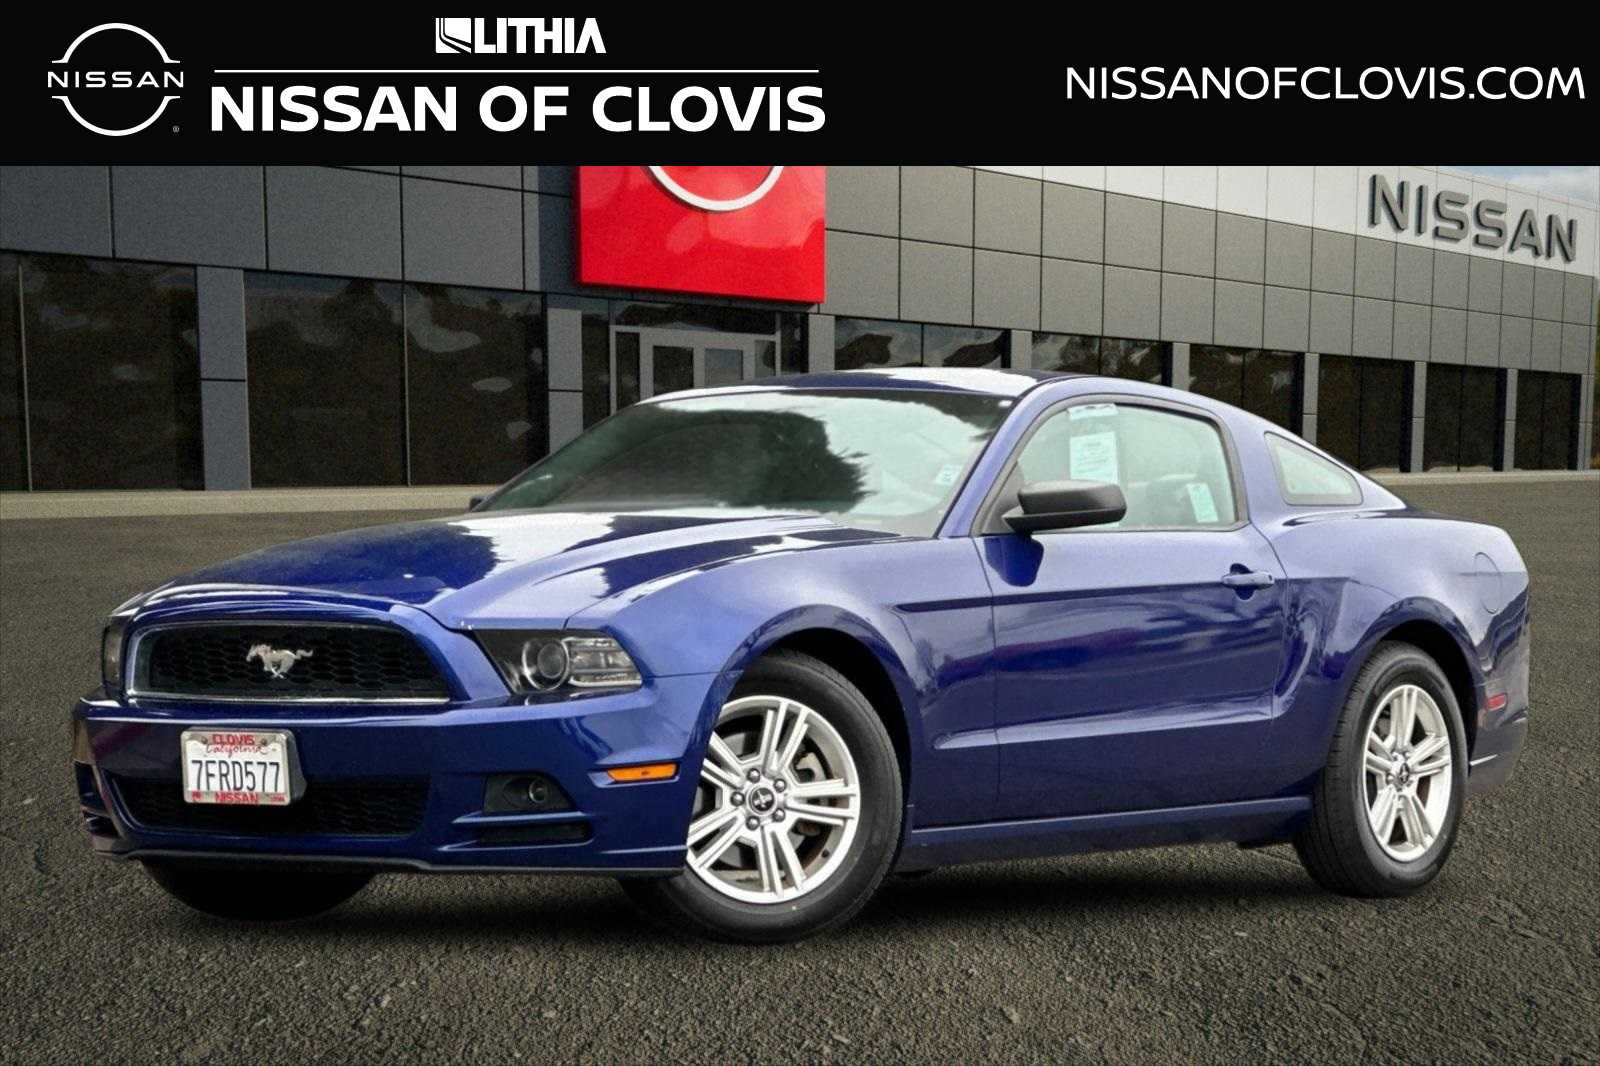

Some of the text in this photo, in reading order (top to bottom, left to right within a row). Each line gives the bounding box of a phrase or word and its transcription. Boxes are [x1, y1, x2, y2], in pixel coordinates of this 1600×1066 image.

[1368, 173, 1578, 263] NISSAN
[212, 734, 255, 745] CLOVIS
[191, 760, 280, 792] 7FRD577
[215, 793, 259, 803] NISSAN
